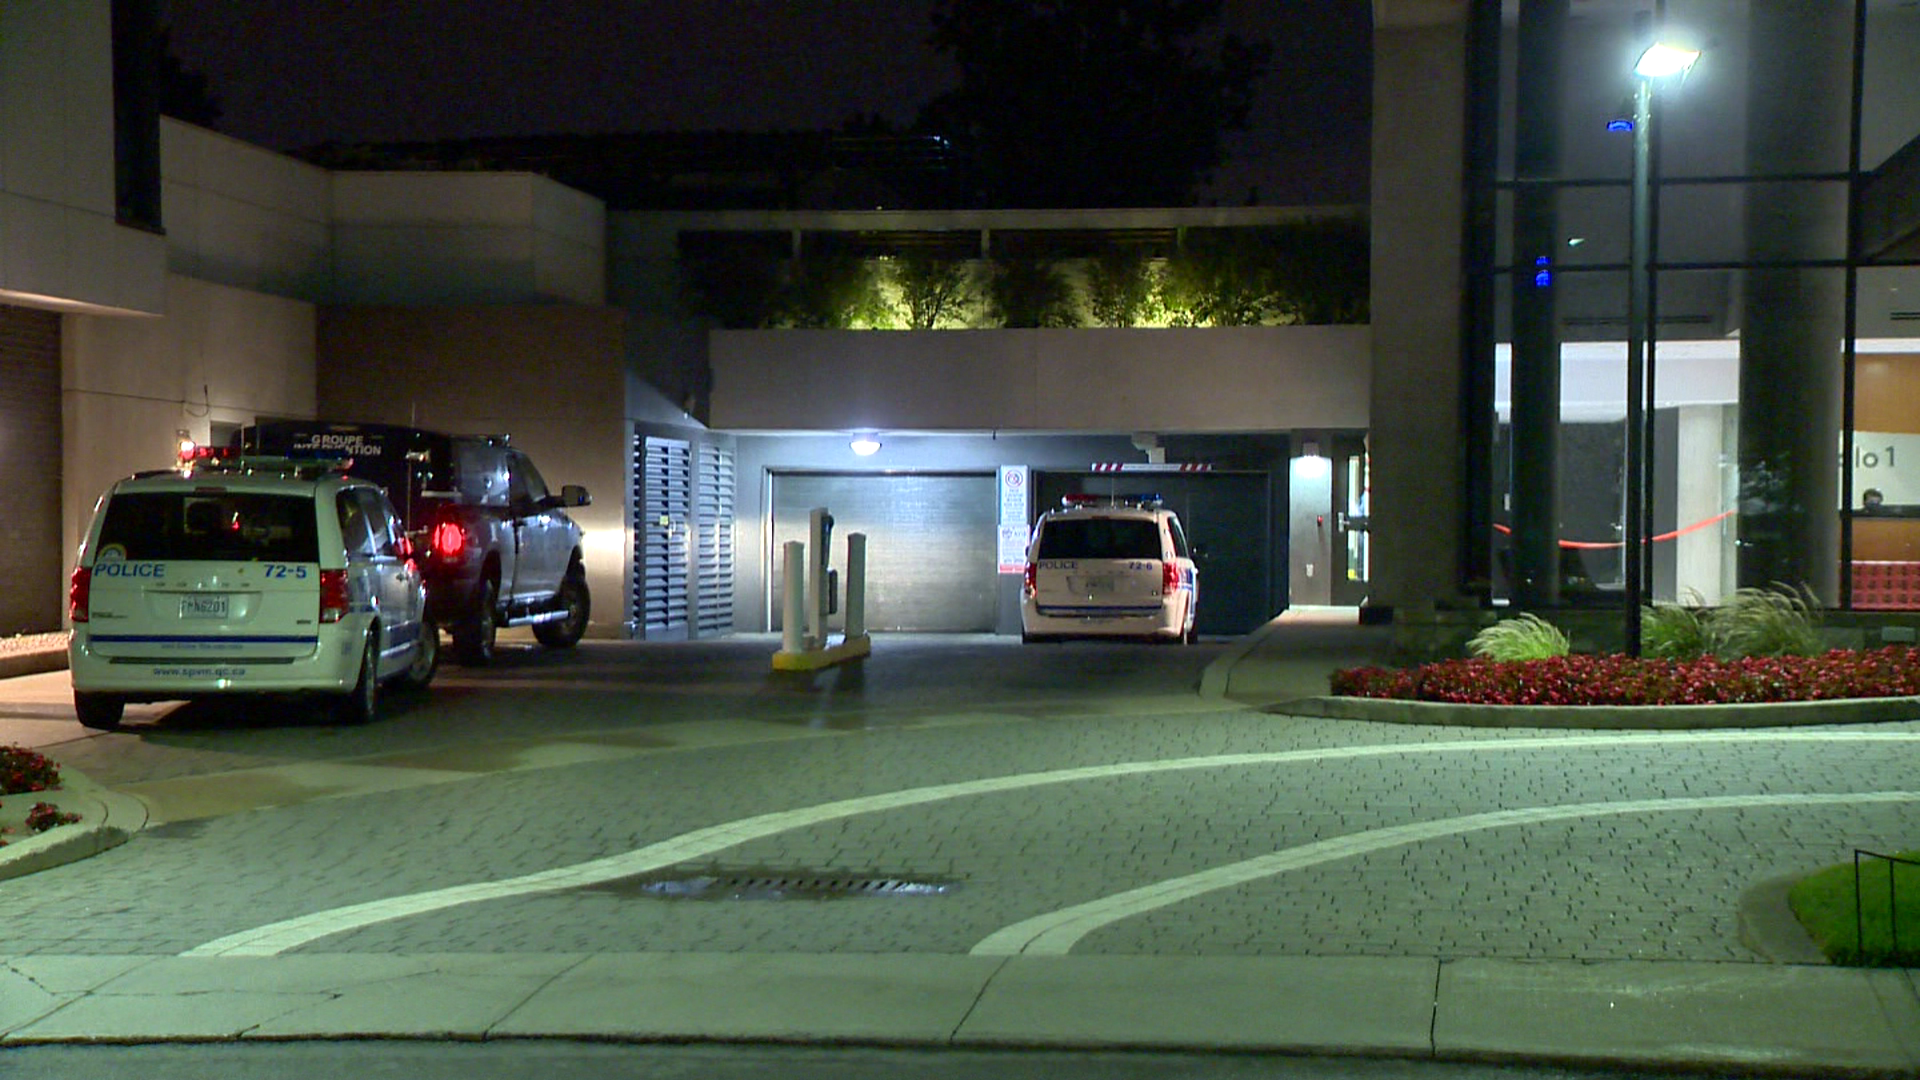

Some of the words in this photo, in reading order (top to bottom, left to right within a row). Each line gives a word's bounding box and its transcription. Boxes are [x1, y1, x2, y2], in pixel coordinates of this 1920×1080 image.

[312, 434, 364, 446] GROUPE
[94, 563, 166, 578] POLICE
[264, 564, 308, 579] 72-5
[1038, 560, 1078, 570] POLICE
